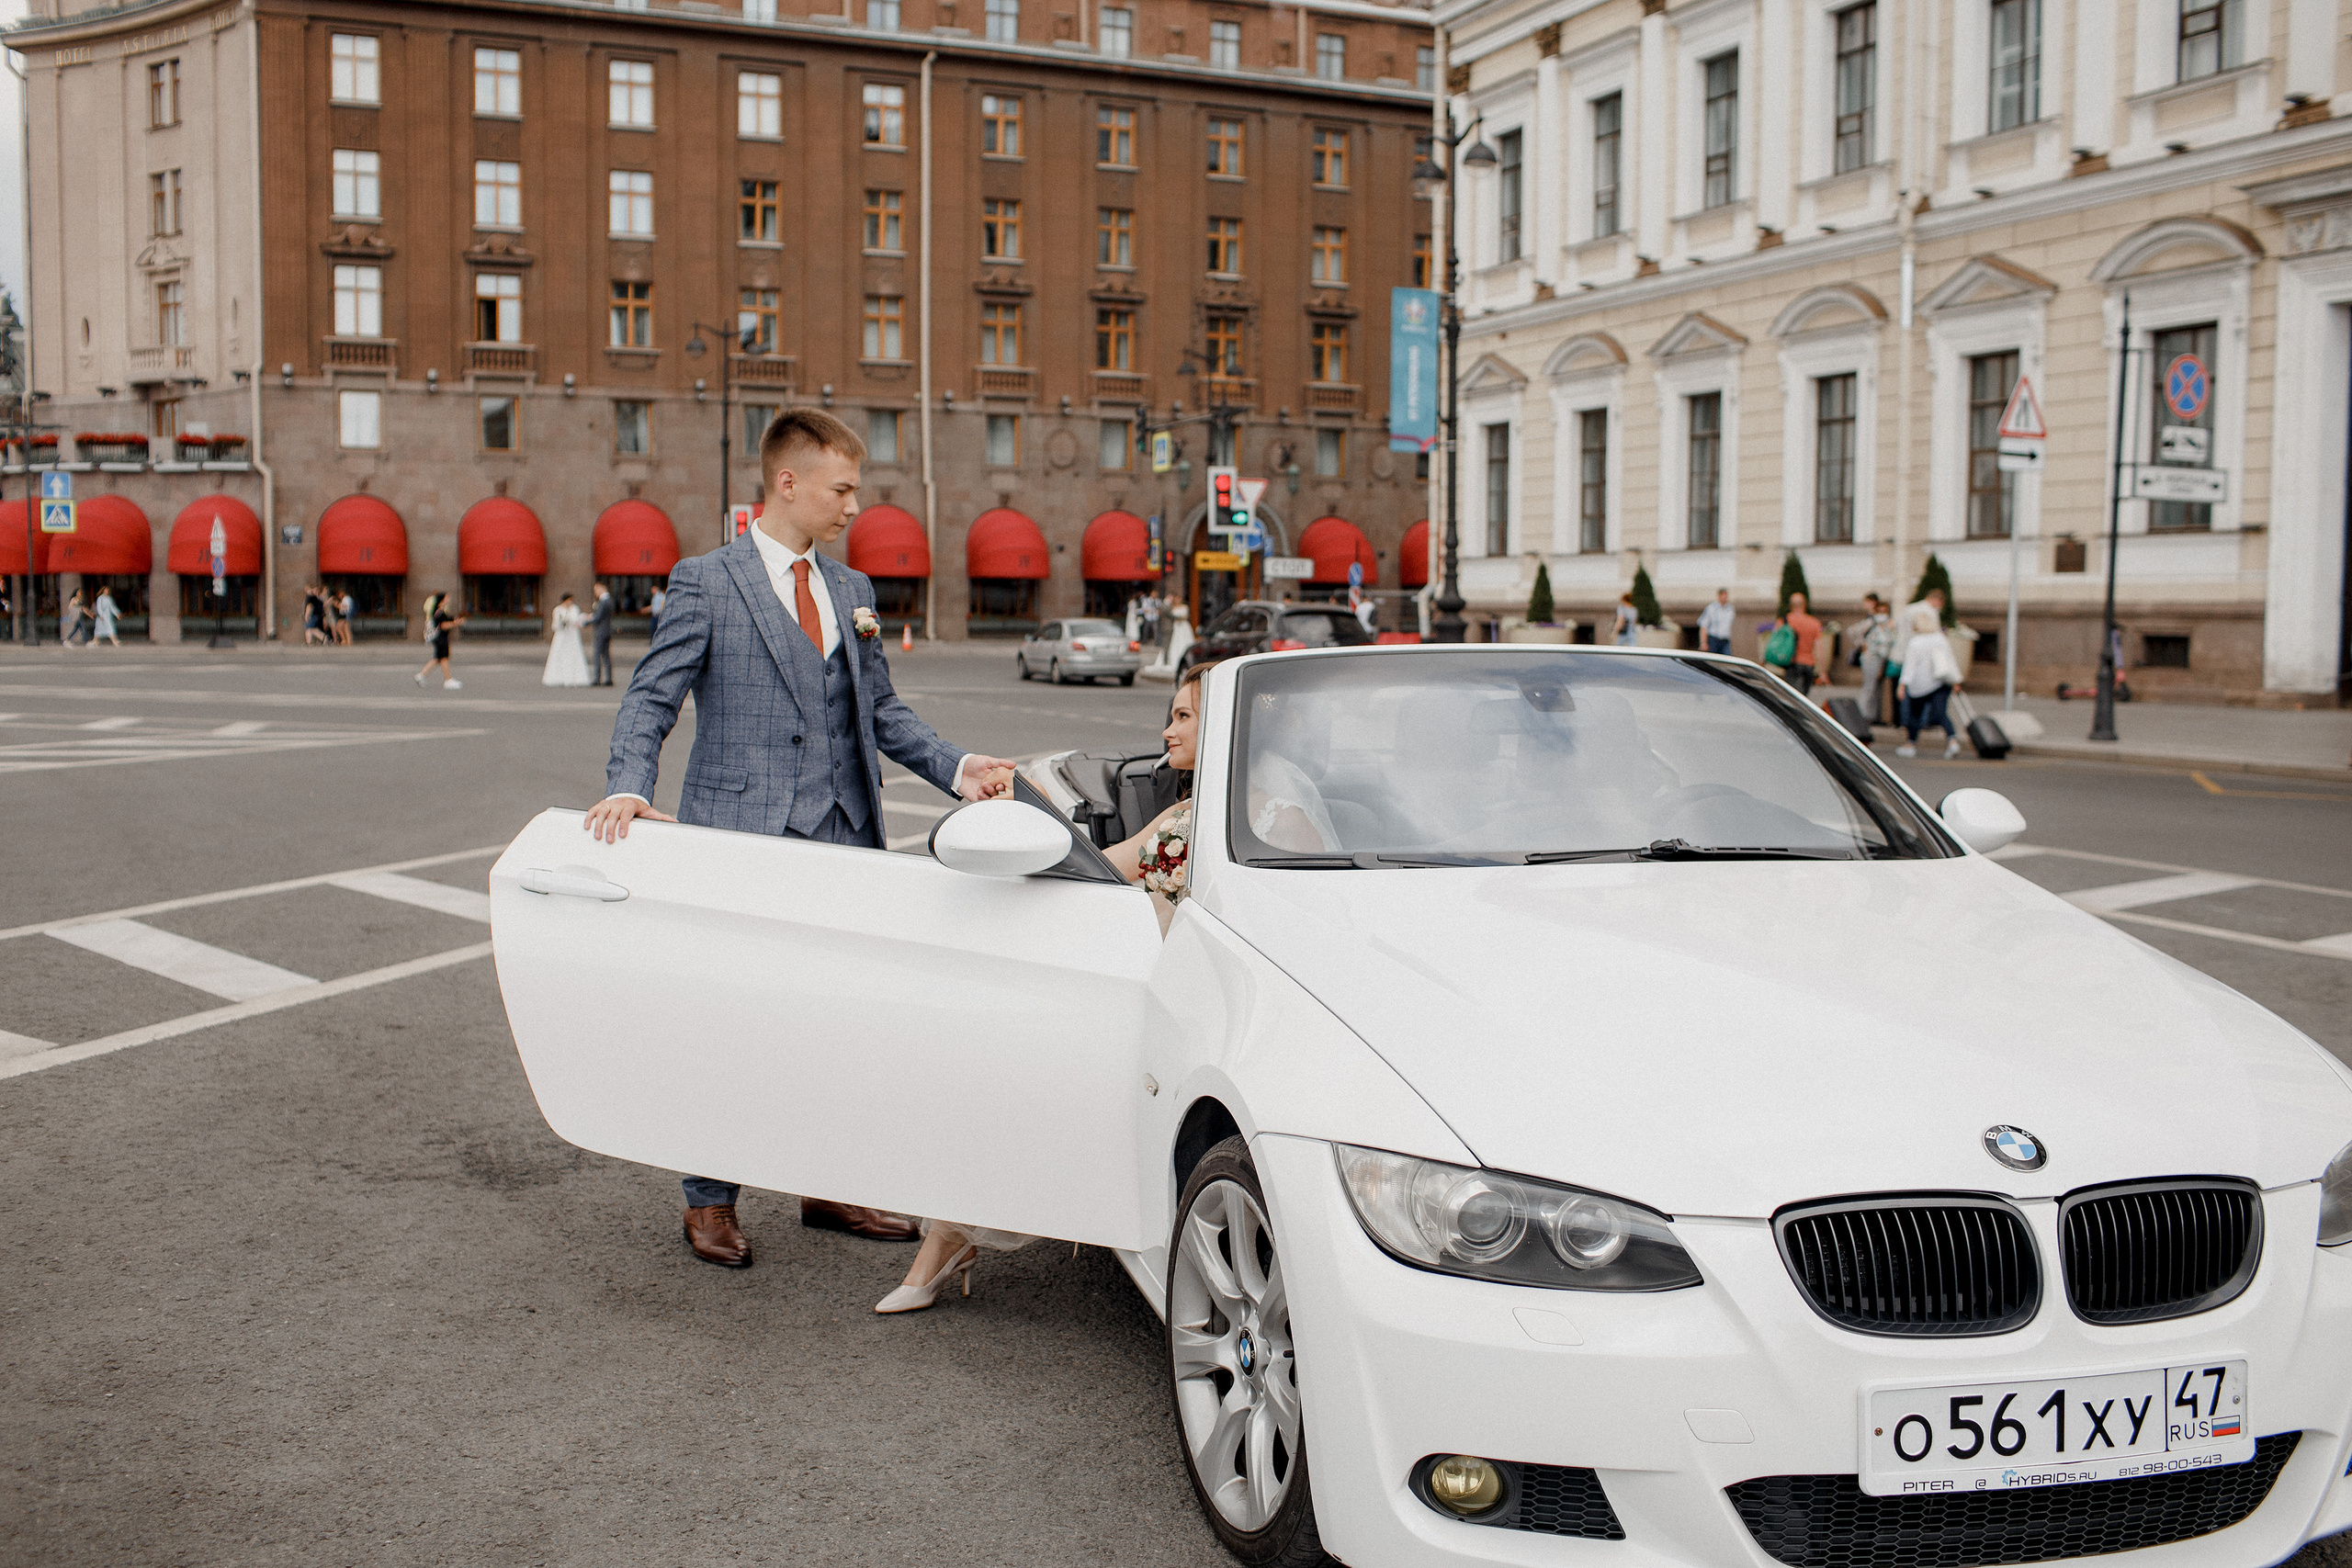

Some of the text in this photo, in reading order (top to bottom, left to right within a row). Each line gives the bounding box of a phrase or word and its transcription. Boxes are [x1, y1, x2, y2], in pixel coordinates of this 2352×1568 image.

[55, 46, 91, 66] HOTEL
[122, 26, 187, 55] ASTORIA
[1985, 1125, 2033, 1140] BMW
[2174, 1366, 2226, 1418] 47
[2169, 1420, 2210, 1443] RUS
[1903, 1479, 1954, 1493] PITER
[2119, 1466, 2140, 1477] 812
[2143, 1454, 2222, 1474] 98-00-543
